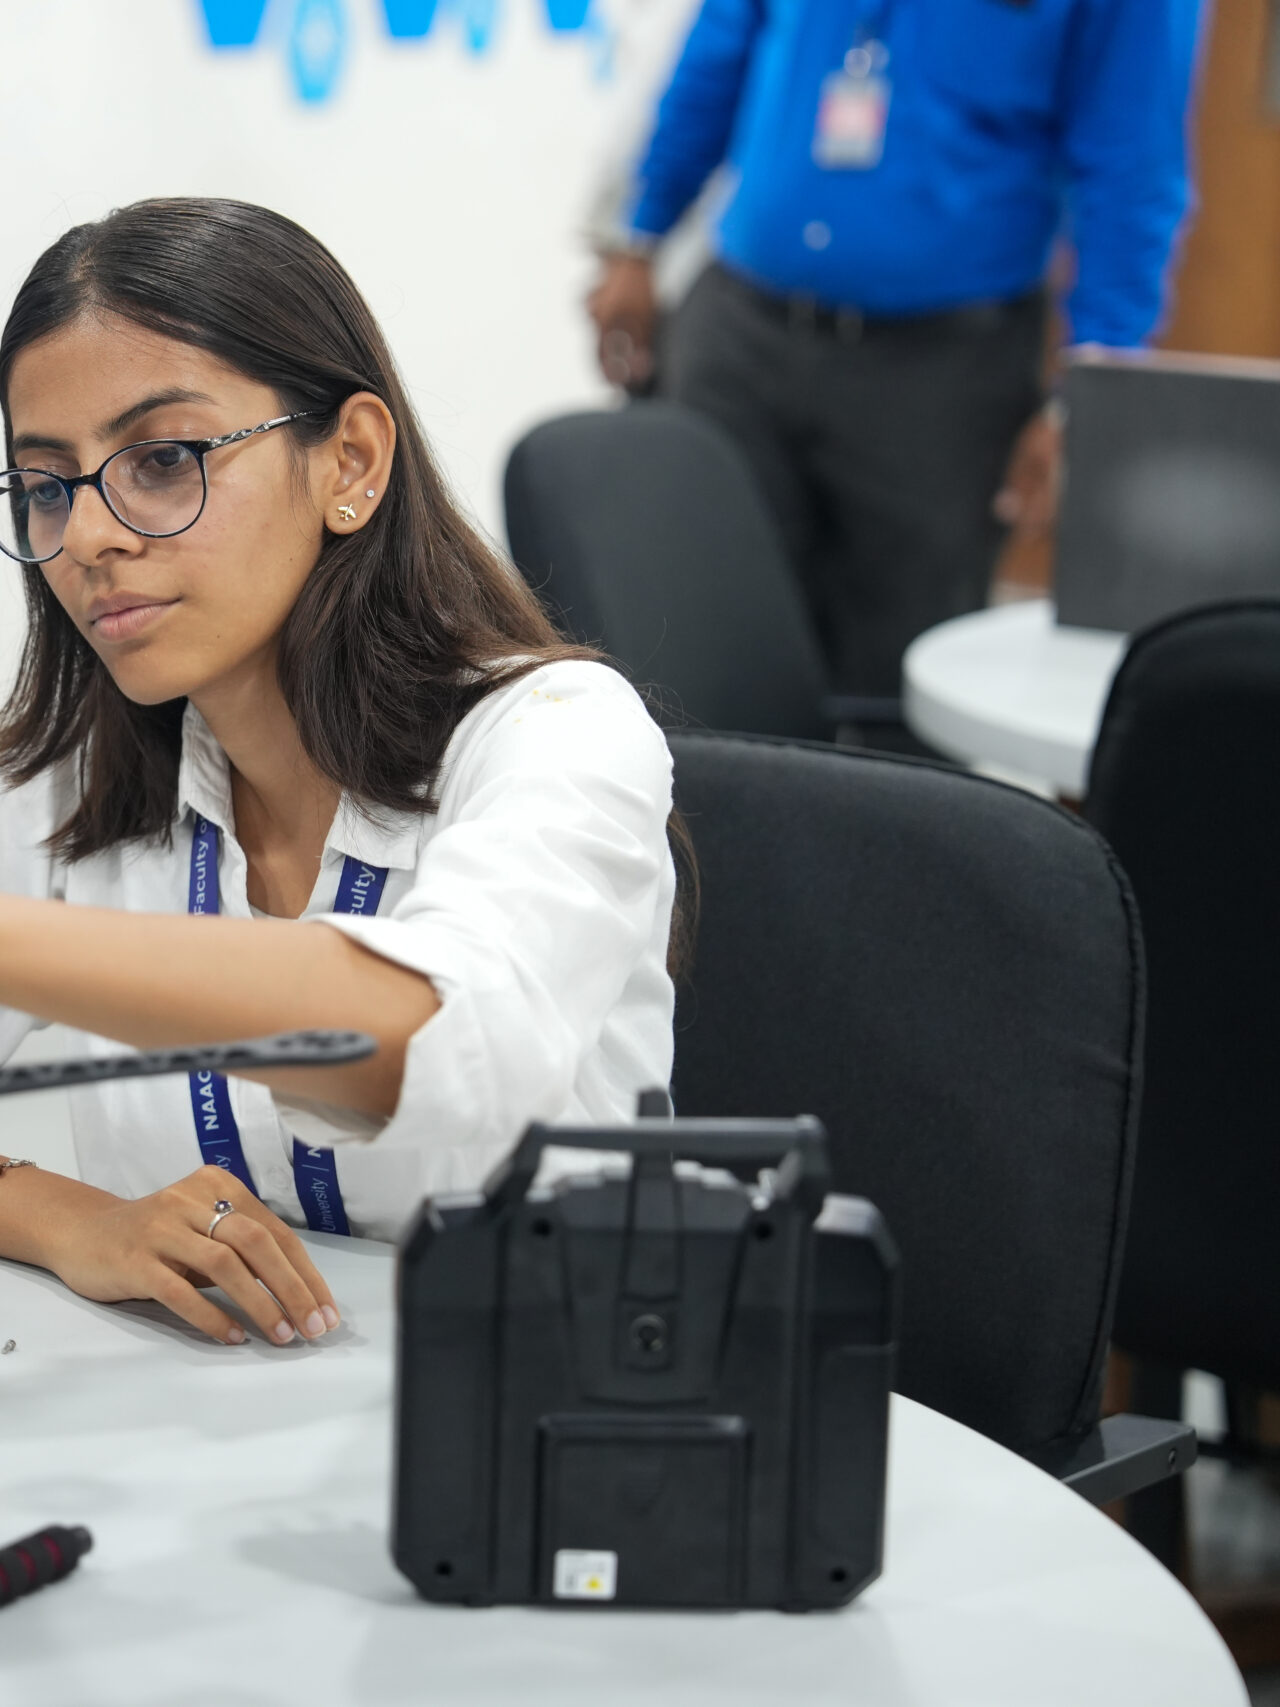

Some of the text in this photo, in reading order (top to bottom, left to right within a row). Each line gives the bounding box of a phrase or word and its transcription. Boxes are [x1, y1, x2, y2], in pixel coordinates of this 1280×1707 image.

[194, 840, 209, 915] Faculty
[197, 1069, 219, 1130] NAAC
[310, 1177, 336, 1232] University
